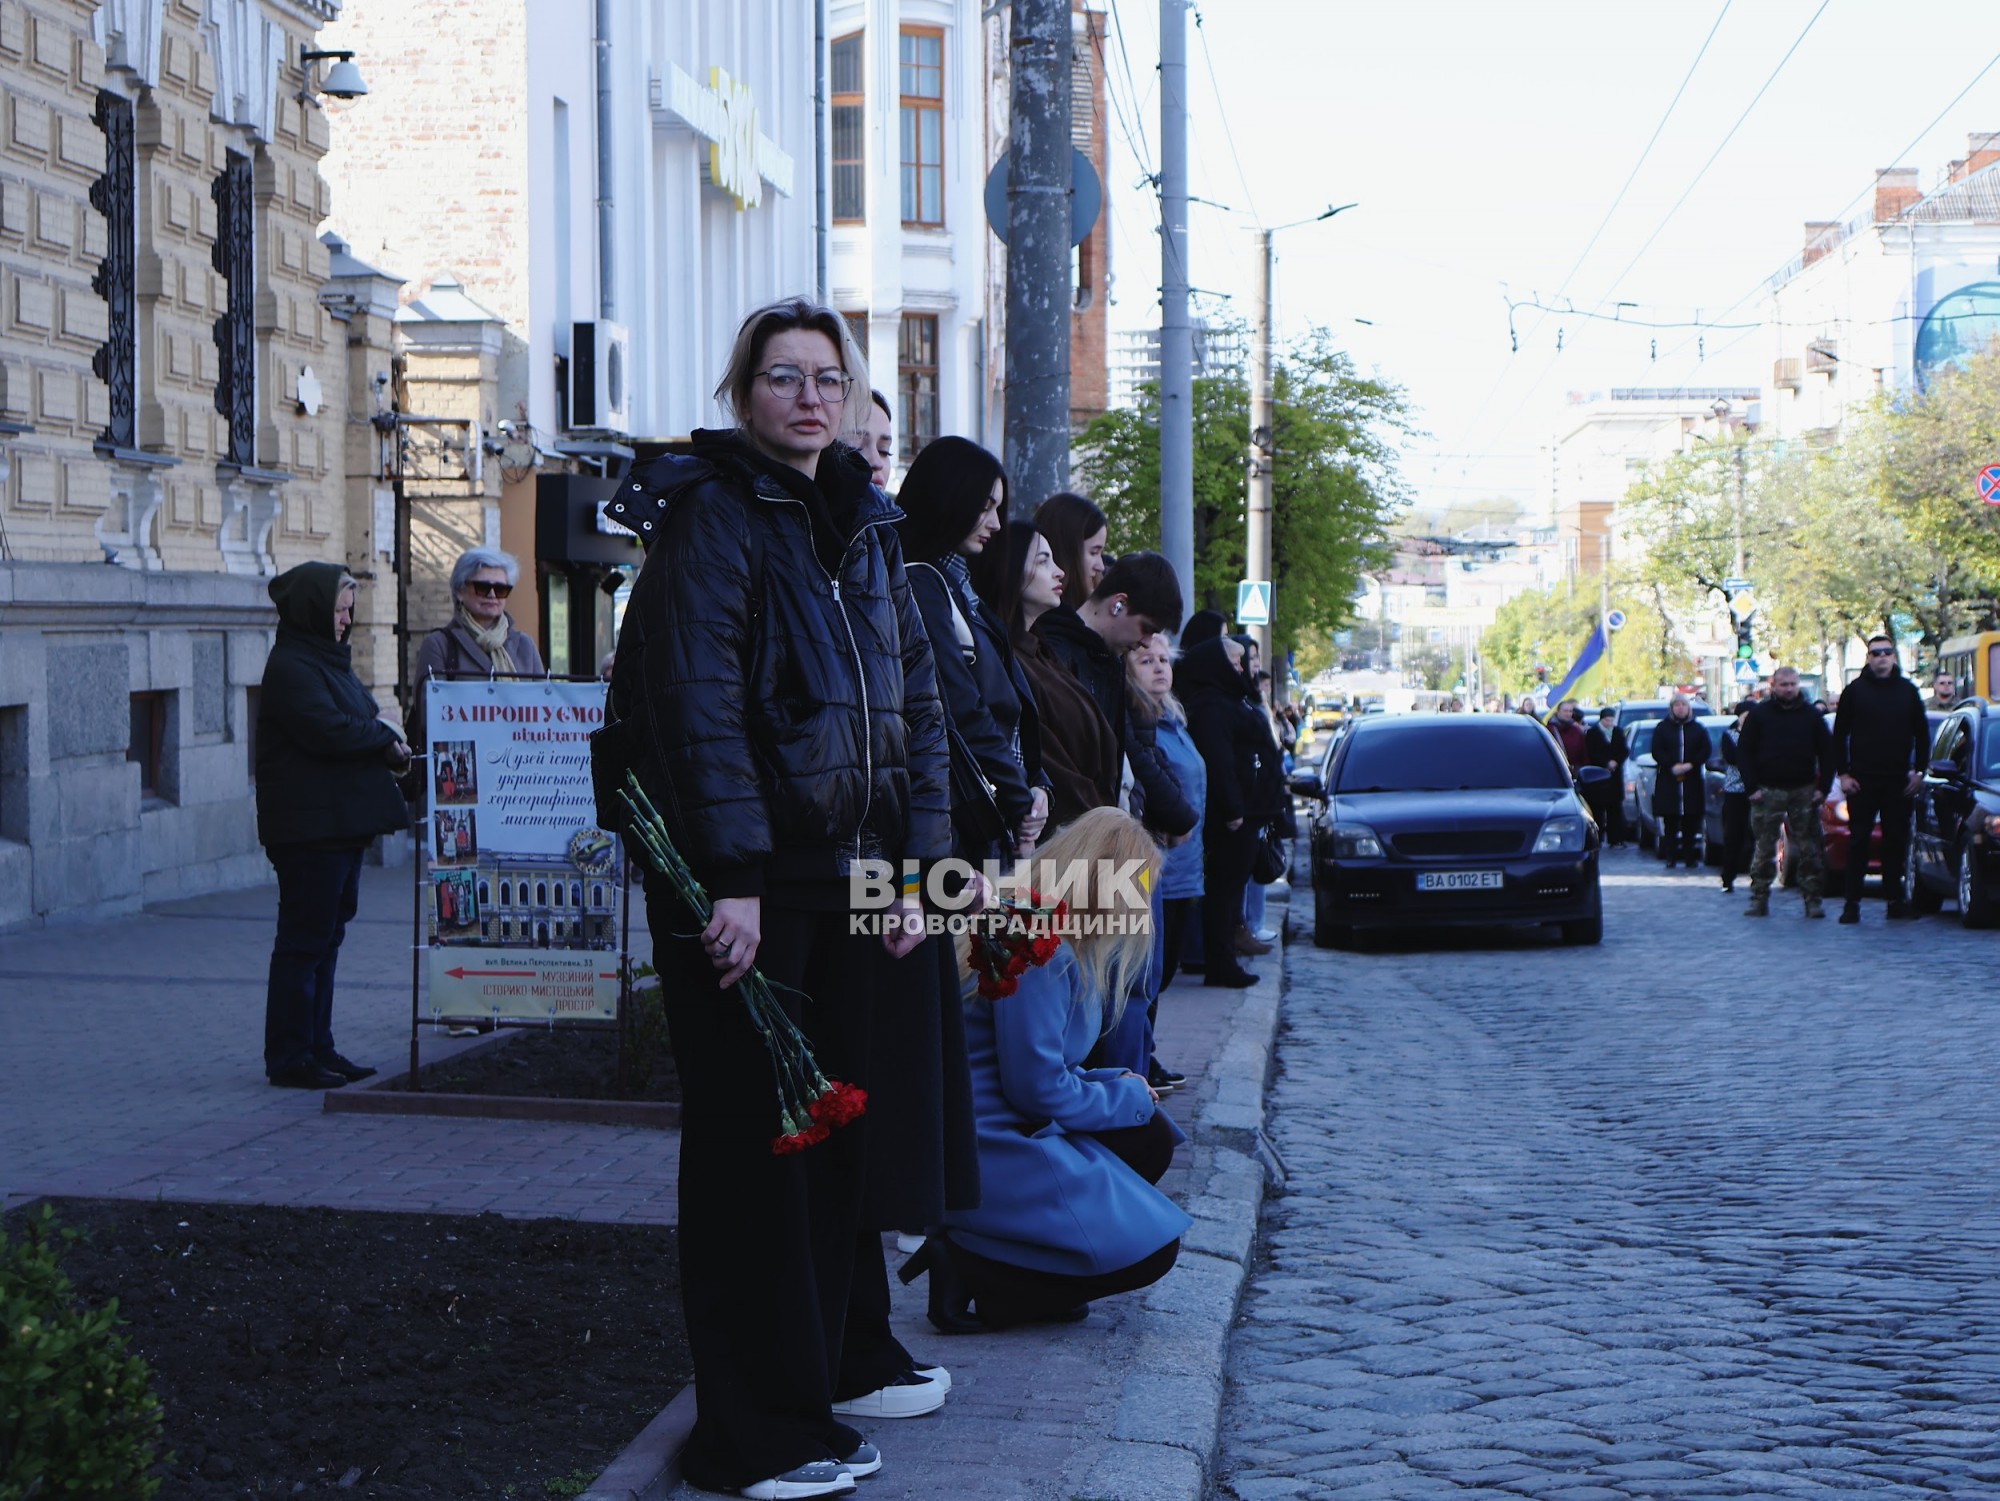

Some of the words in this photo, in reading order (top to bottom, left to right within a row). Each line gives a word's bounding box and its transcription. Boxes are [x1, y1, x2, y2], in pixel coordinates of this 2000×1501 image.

[441, 704, 603, 723] ЗАПРОШУЄМО
[512, 728, 592, 745] відвідати
[487, 747, 545, 771] Музей
[550, 750, 590, 771] істор
[497, 773, 588, 791] українського
[501, 815, 587, 829] мистецтва
[1425, 875, 1445, 888] BA
[1448, 873, 1479, 887] 0102
[1482, 872, 1501, 886] ET
[584, 959, 593, 967] 33
[542, 971, 594, 983] МУЗЕЙНИЙ
[483, 984, 594, 998] ІСТОРИКО-МИСТЕЦЬКИЙ
[555, 999, 595, 1011] ПРОСТІР
